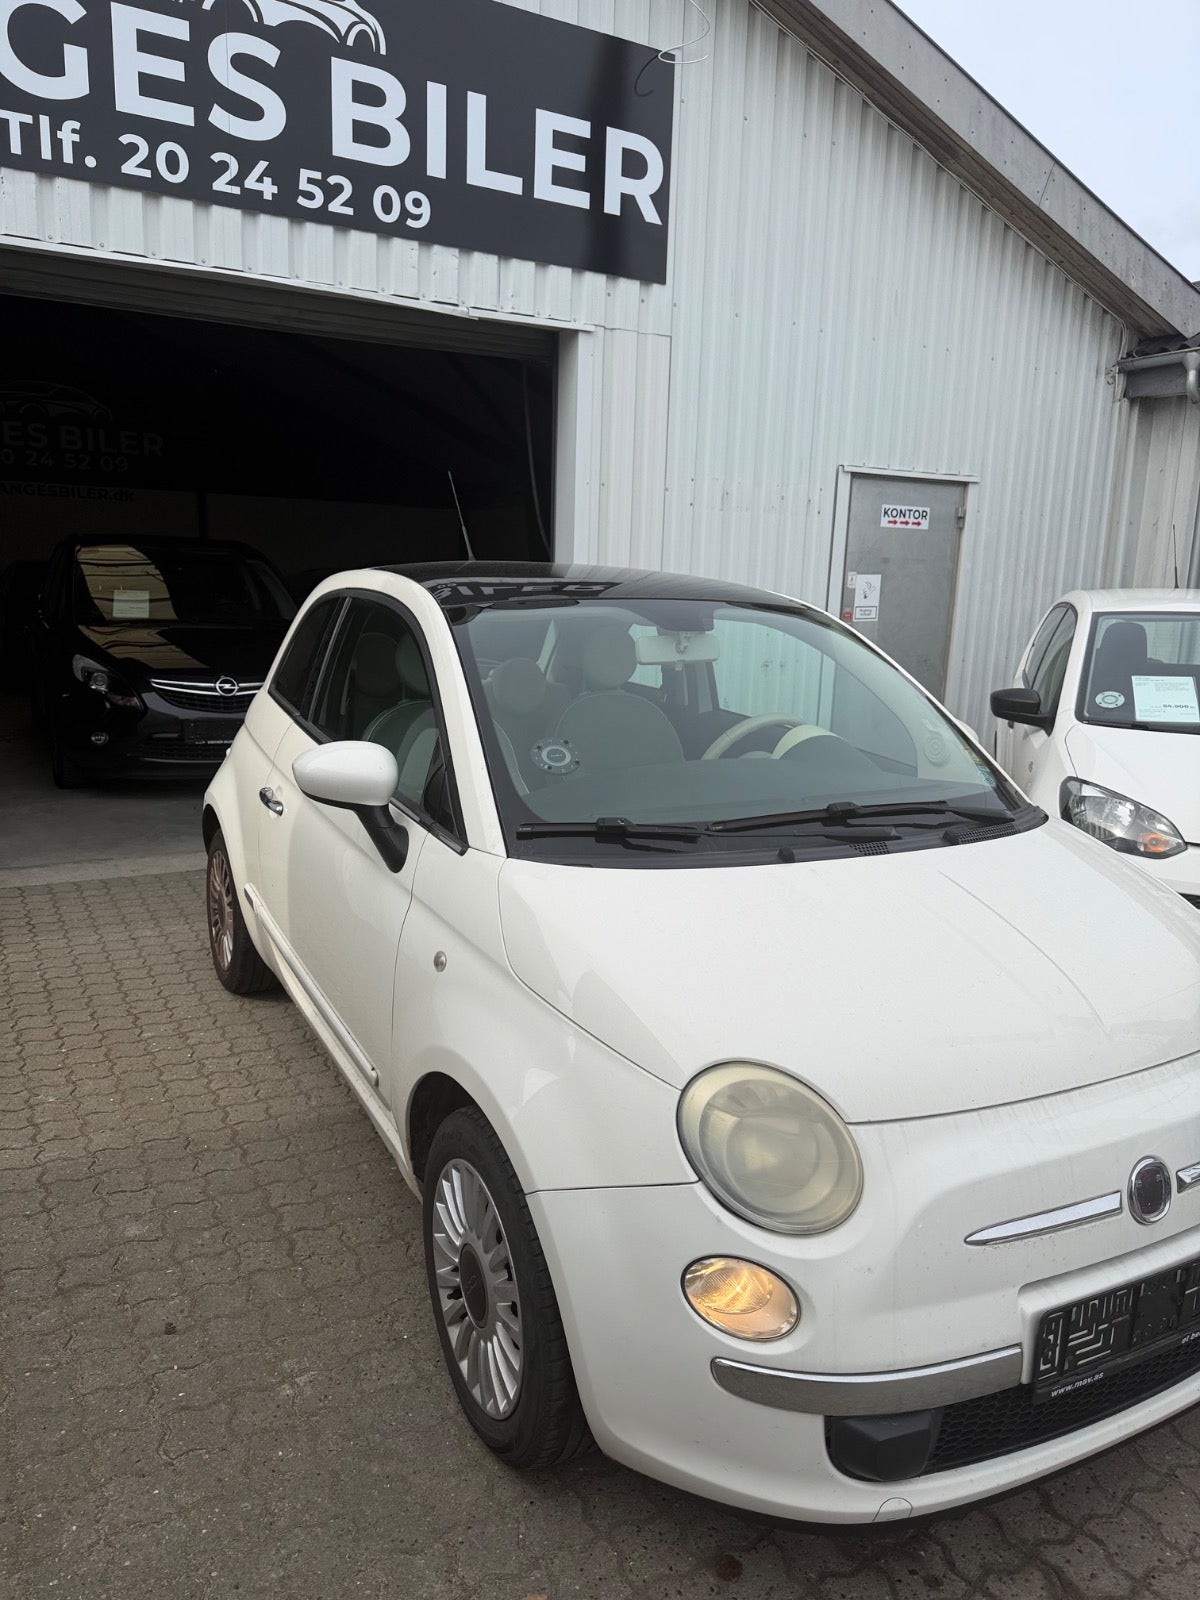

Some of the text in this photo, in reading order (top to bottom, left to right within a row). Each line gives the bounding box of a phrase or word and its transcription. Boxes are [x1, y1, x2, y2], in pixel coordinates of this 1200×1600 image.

[331, 57, 664, 225] BILER
[0, 109, 431, 229] Tlf. 20 24 52 09
[59, 424, 166, 456] BILER
[24, 449, 55, 467] 24
[64, 453, 92, 470] 52
[100, 455, 128, 472] 09
[883, 507, 928, 520] KONTOR
[1051, 1371, 1104, 1397] www.mav.as
